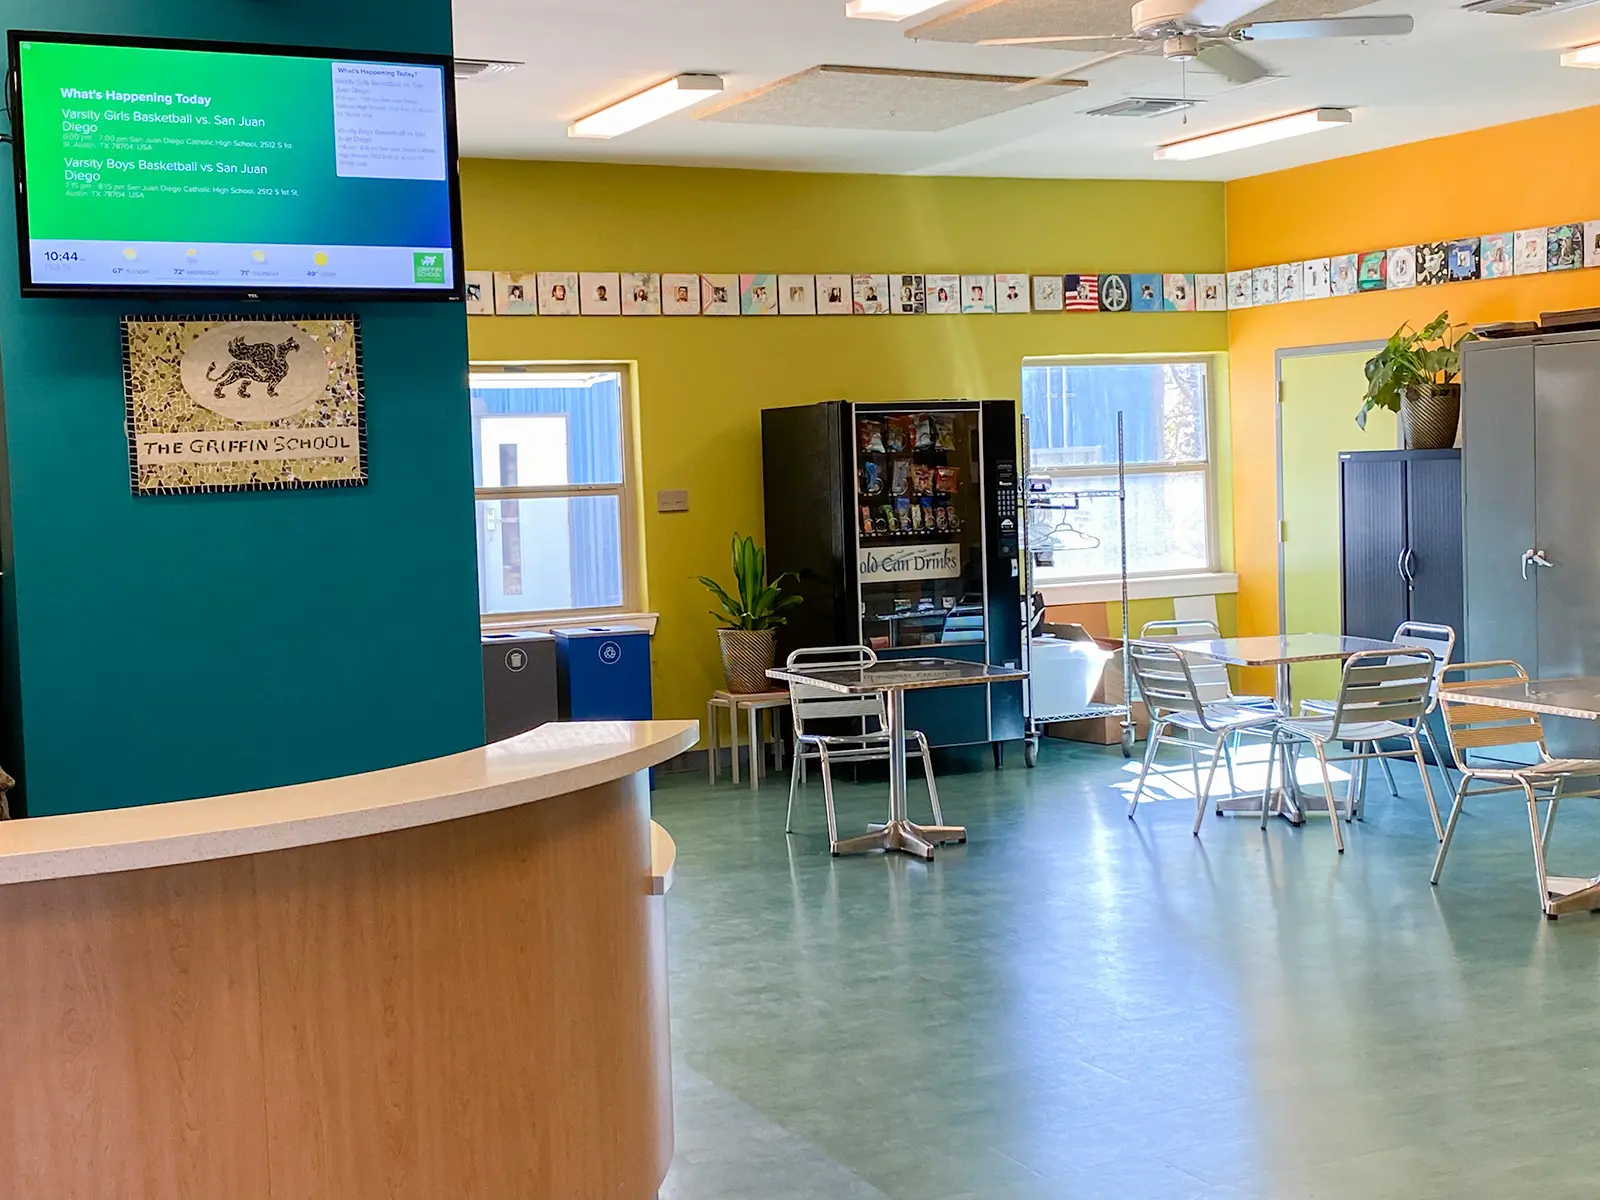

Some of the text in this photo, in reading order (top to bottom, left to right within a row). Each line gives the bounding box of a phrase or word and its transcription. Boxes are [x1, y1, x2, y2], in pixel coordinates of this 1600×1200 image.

[360, 69, 394, 77] Happening
[60, 88, 212, 107] What's Happening Today
[61, 108, 265, 127] Varsity Girls Basketball vs. San Juan
[62, 121, 98, 134] Diego
[64, 157, 268, 174] Varsity Boys Basketball vs San Juan
[64, 170, 100, 183] Diego
[160, 185, 182, 193] Diego
[212, 186, 228, 194] High
[44, 251, 78, 261] 10:44
[144, 436, 350, 454] THE GRIFFIN SCHOOL
[860, 548, 956, 574] old Can Drinks
